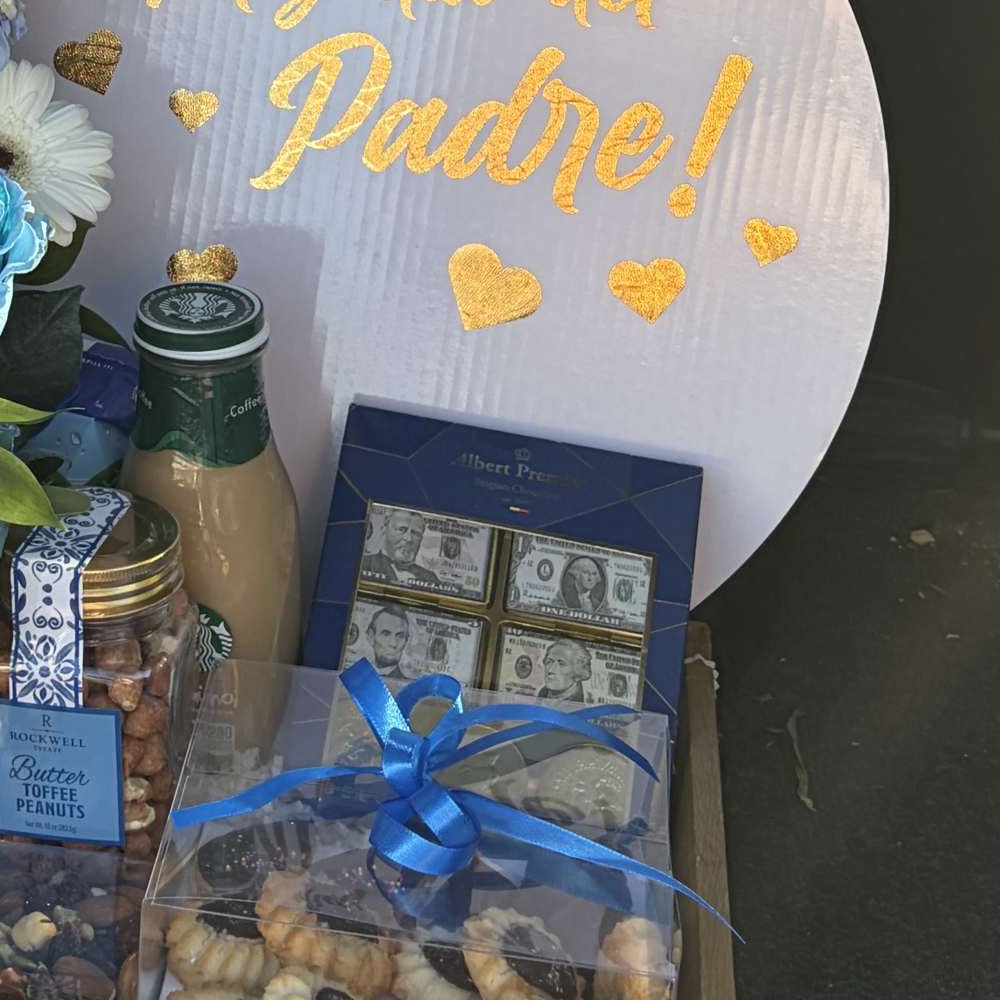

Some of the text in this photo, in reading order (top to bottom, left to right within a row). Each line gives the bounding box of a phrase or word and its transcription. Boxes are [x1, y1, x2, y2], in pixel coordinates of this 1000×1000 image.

[249, 31, 754, 219] Padre!
[41, 713, 53, 728] R
[10, 730, 87, 748] ROCKWELL
[8, 754, 90, 786] Butter
[22, 783, 78, 802] TOFFEE
[16, 798, 85, 819] PEANUTS
